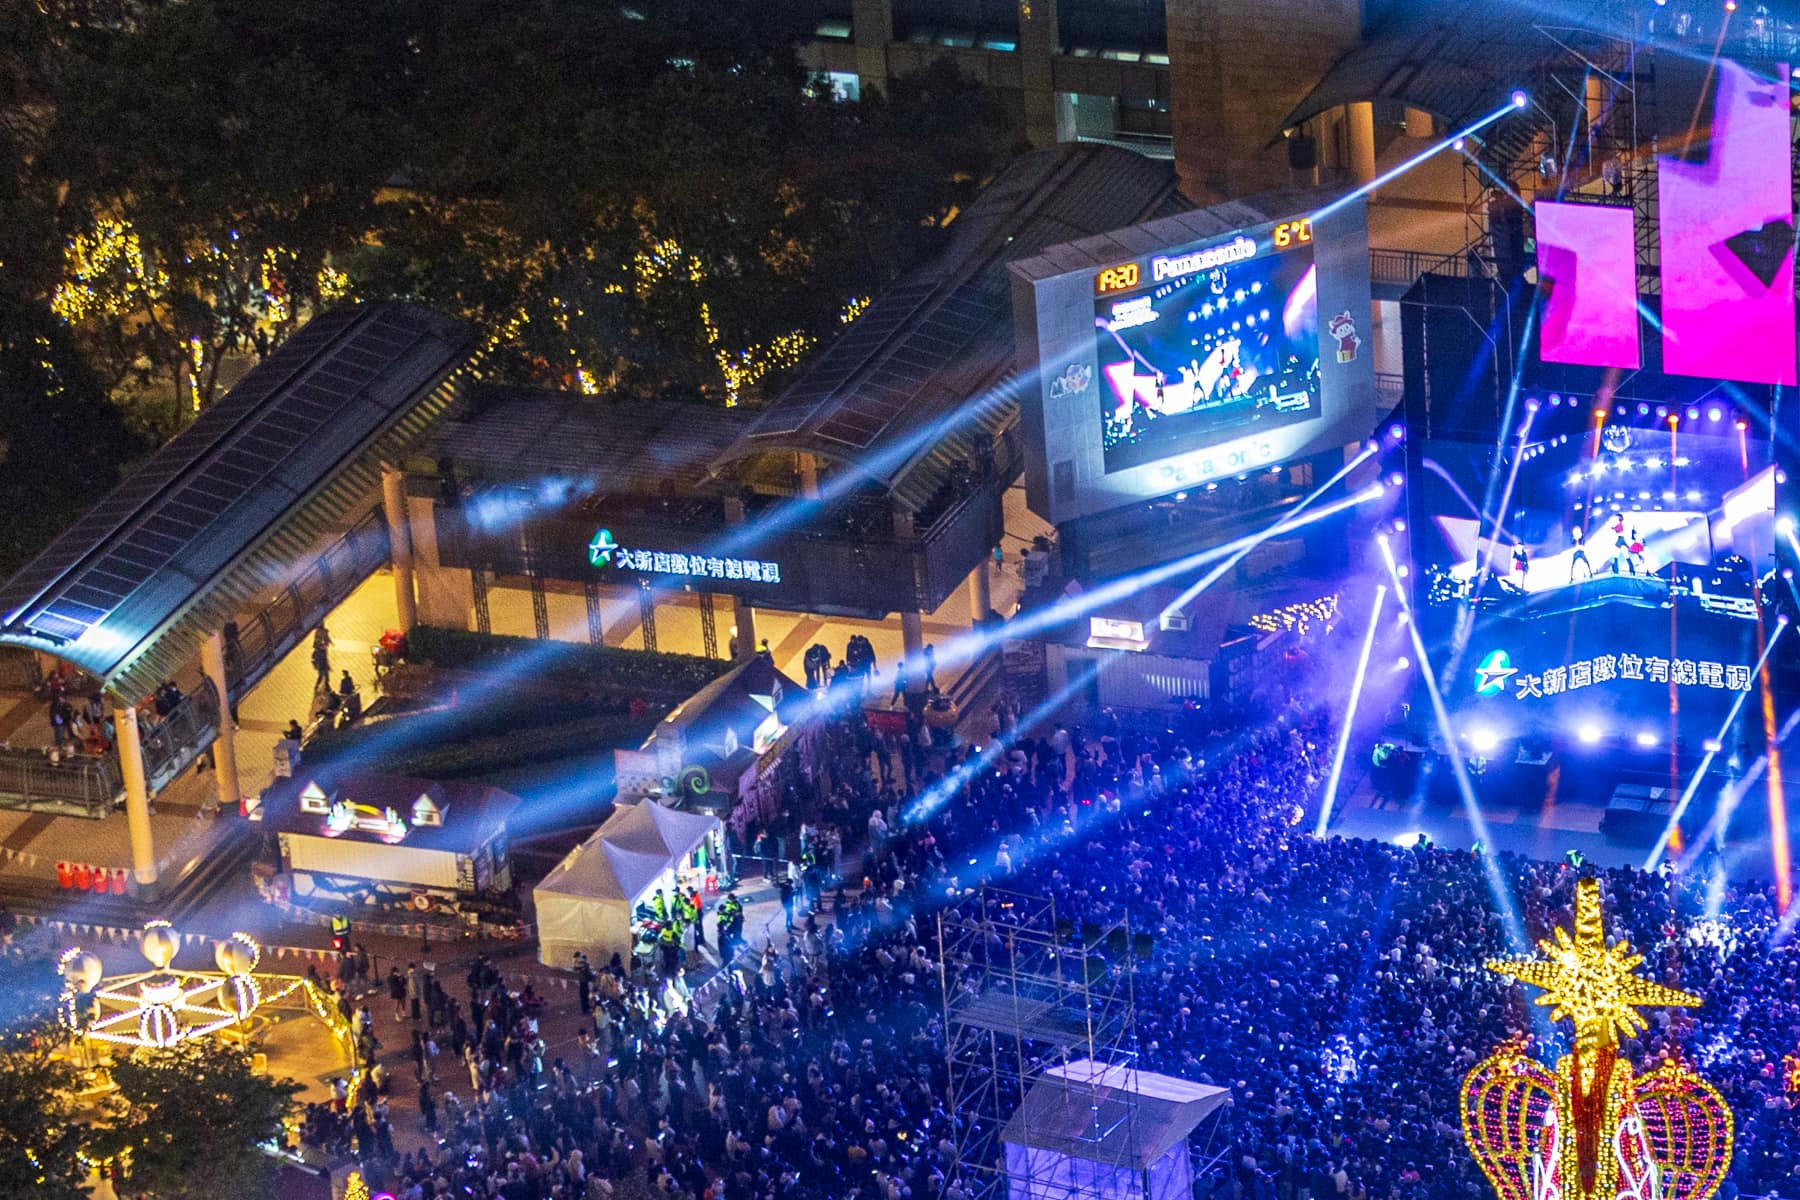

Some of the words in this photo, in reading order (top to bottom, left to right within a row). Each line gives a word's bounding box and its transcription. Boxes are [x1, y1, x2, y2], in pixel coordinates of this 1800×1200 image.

[1515, 652, 1752, 700] 大新店數位有線電視
